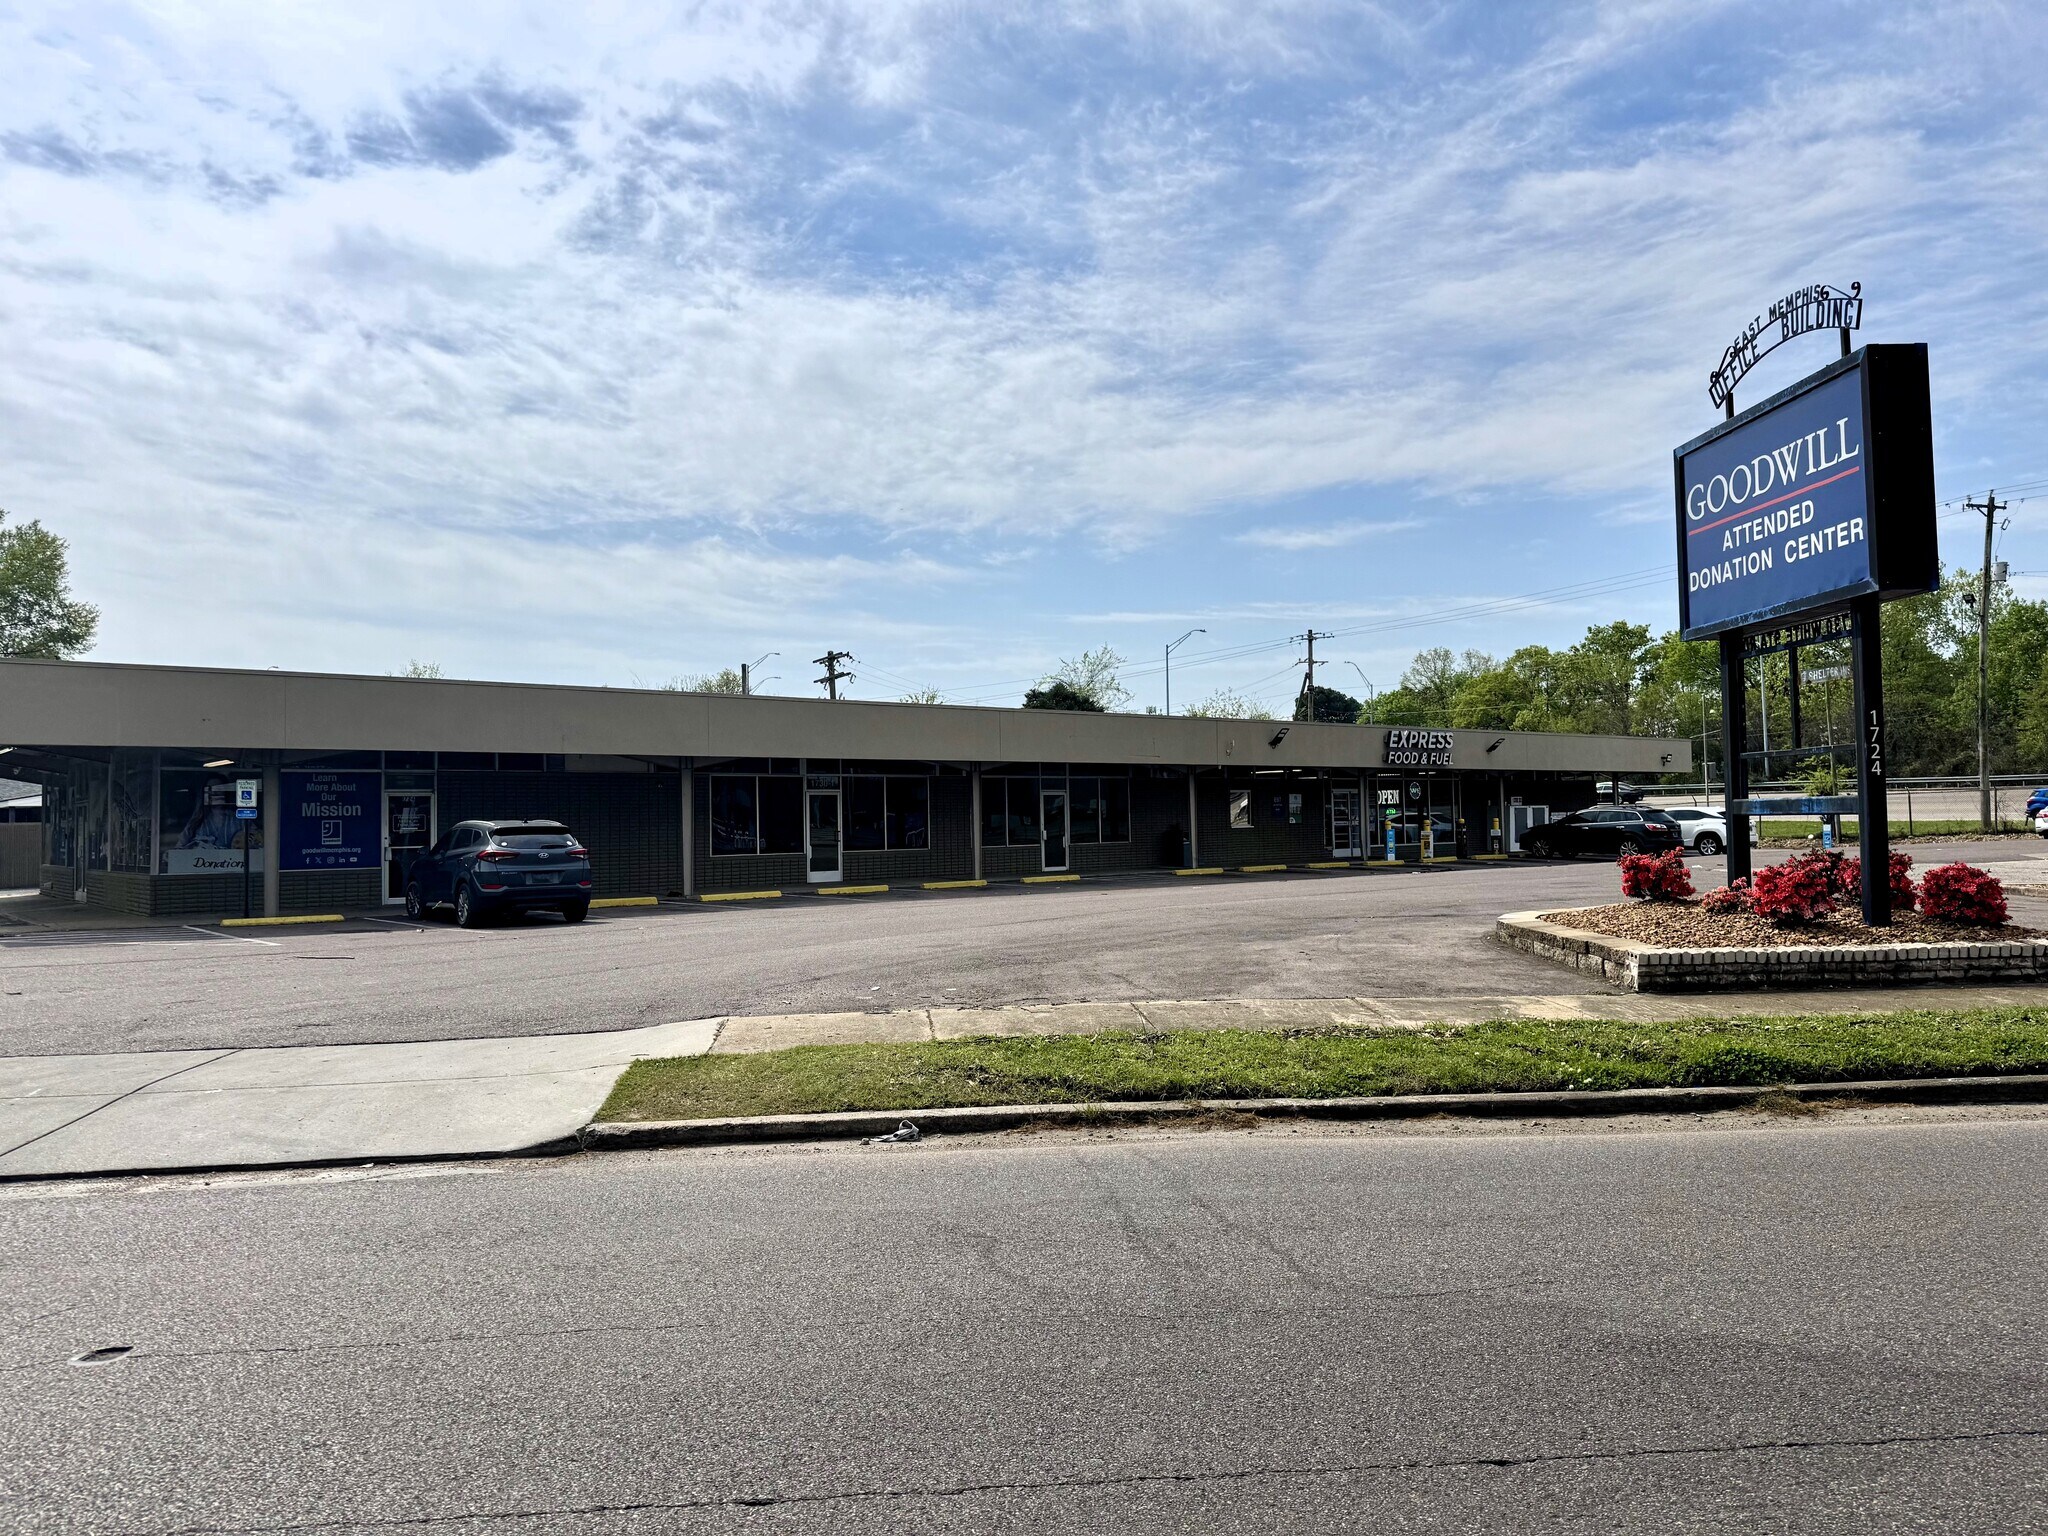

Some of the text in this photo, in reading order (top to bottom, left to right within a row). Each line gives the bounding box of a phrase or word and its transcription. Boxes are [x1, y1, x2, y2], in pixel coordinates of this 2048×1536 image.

[1734, 284, 1821, 350] EAST MEMPHIS
[1713, 300, 1854, 401] OFFICE BUILDING
[1686, 417, 1860, 522] GOODWILL
[1722, 500, 1815, 552] ATTENDED
[1689, 516, 1865, 593] DONATION CENTER
[1808, 667, 1839, 680] SHELTER
[1389, 730, 1454, 749] EXPRESS
[1870, 709, 1882, 776] 1724
[1388, 751, 1454, 765] FOOD & FUEL
[312, 773, 337, 781] Learn
[306, 783, 356, 792] More About
[321, 792, 337, 801] Our
[301, 802, 362, 817] Mission
